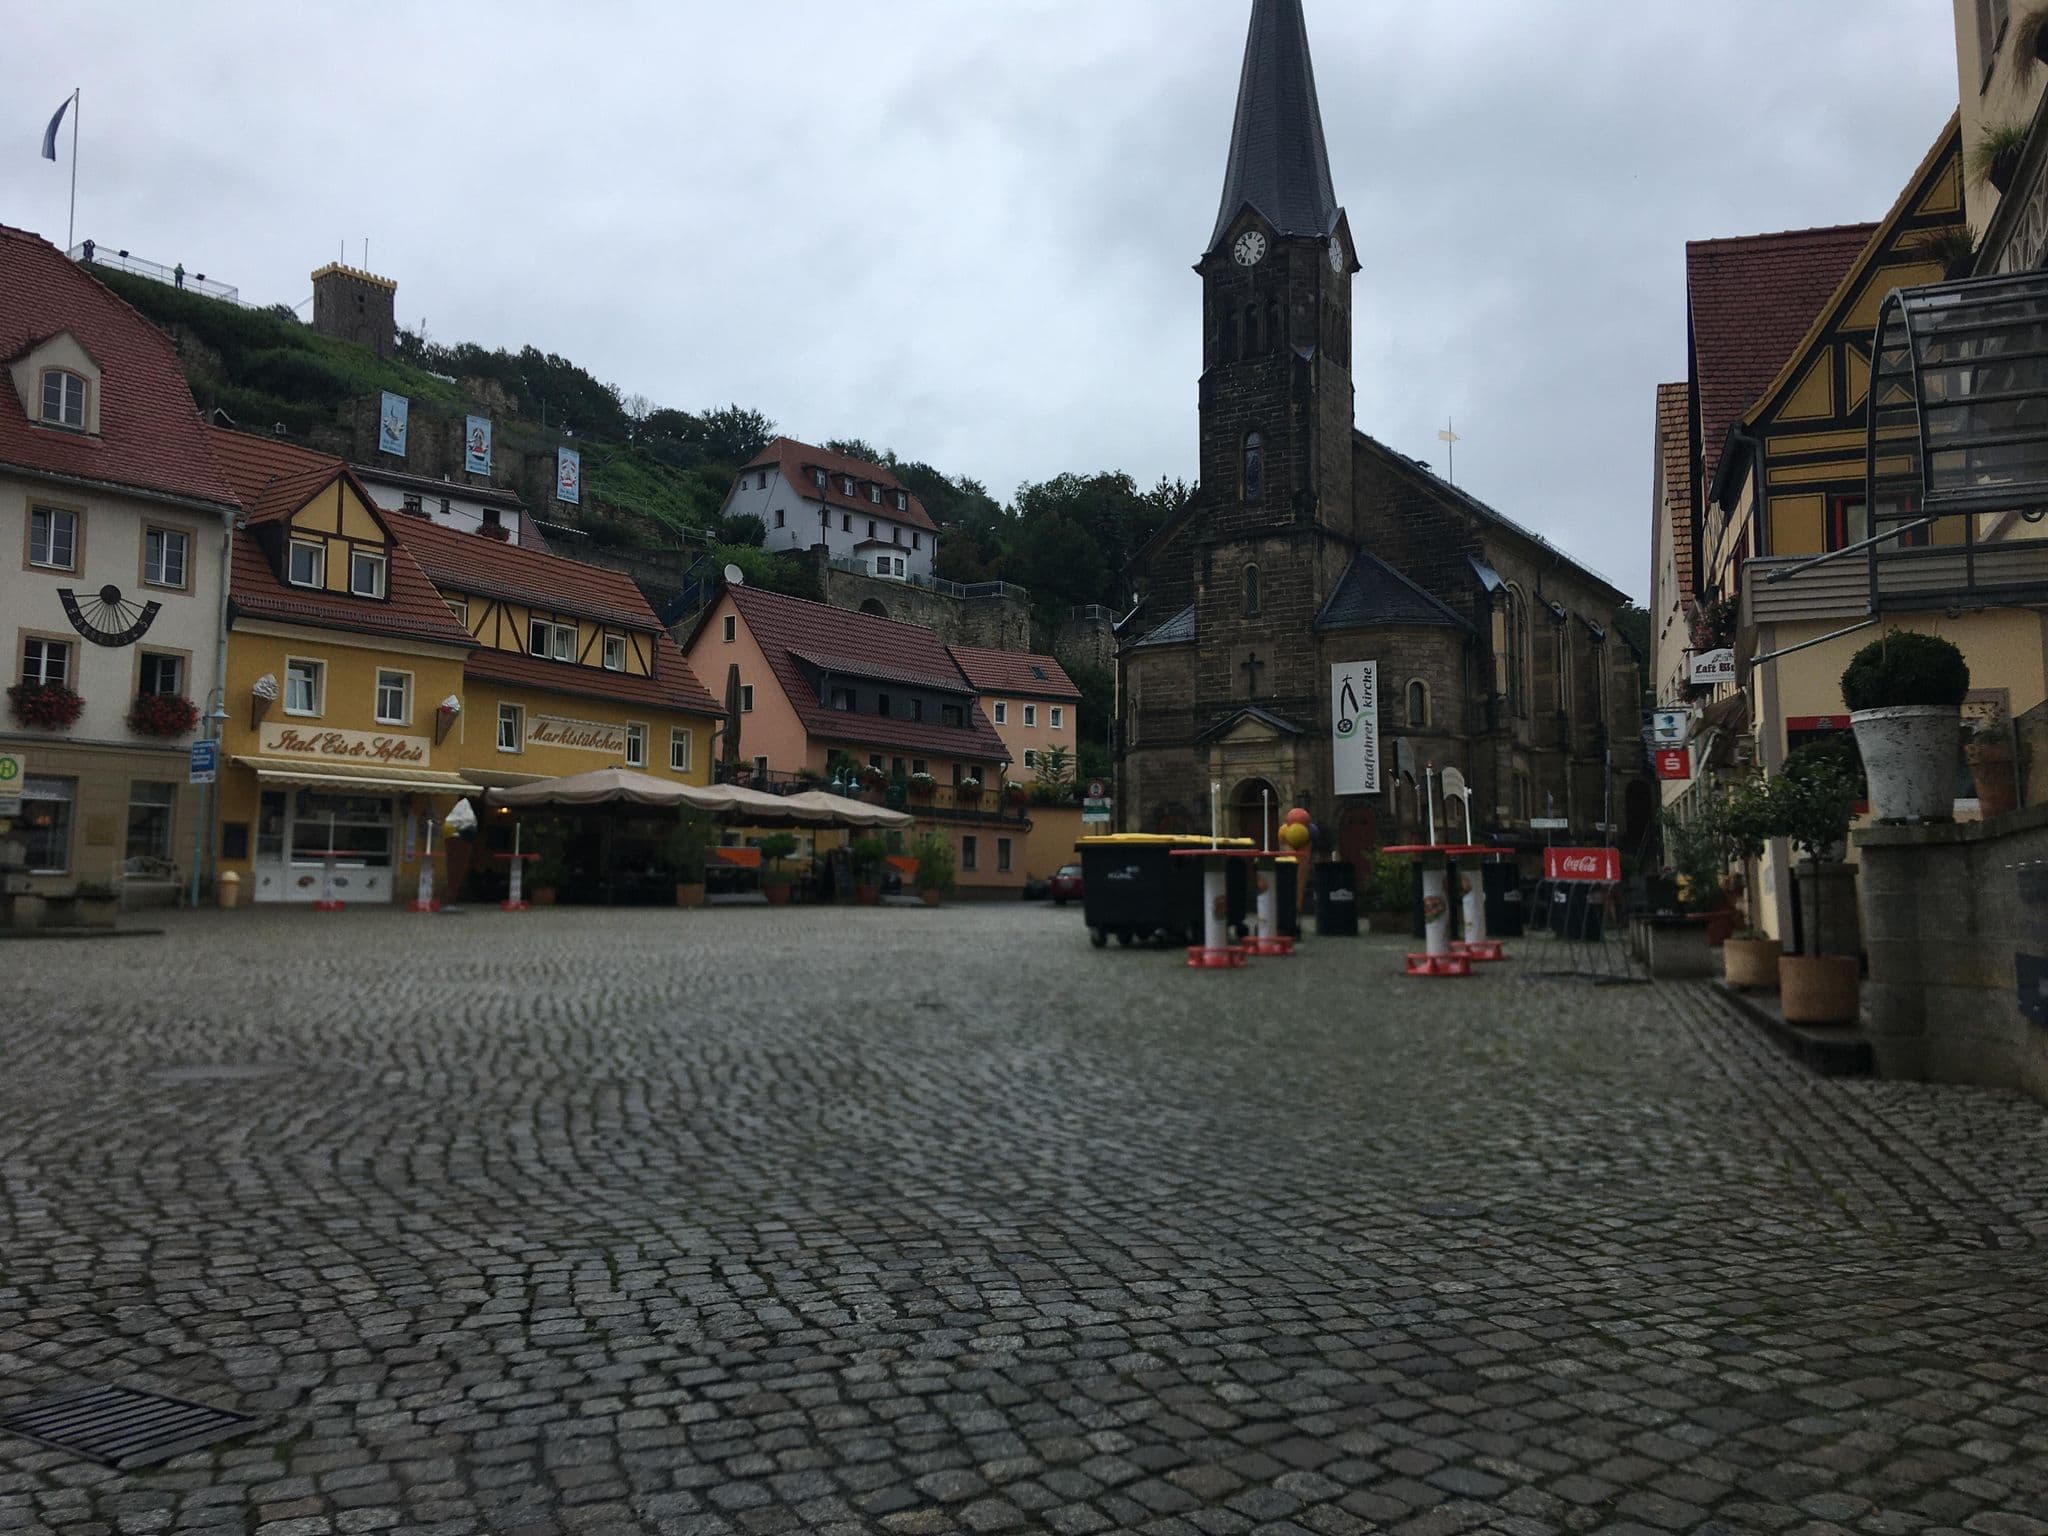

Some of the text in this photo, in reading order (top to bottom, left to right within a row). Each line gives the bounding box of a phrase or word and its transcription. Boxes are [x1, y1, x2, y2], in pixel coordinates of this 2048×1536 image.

[528, 721, 624, 751] Marktstübchen
[1362, 667, 1376, 790] Radfahrer kirche
[321, 732, 349, 756] Eis
[366, 737, 424, 762] Softeis
